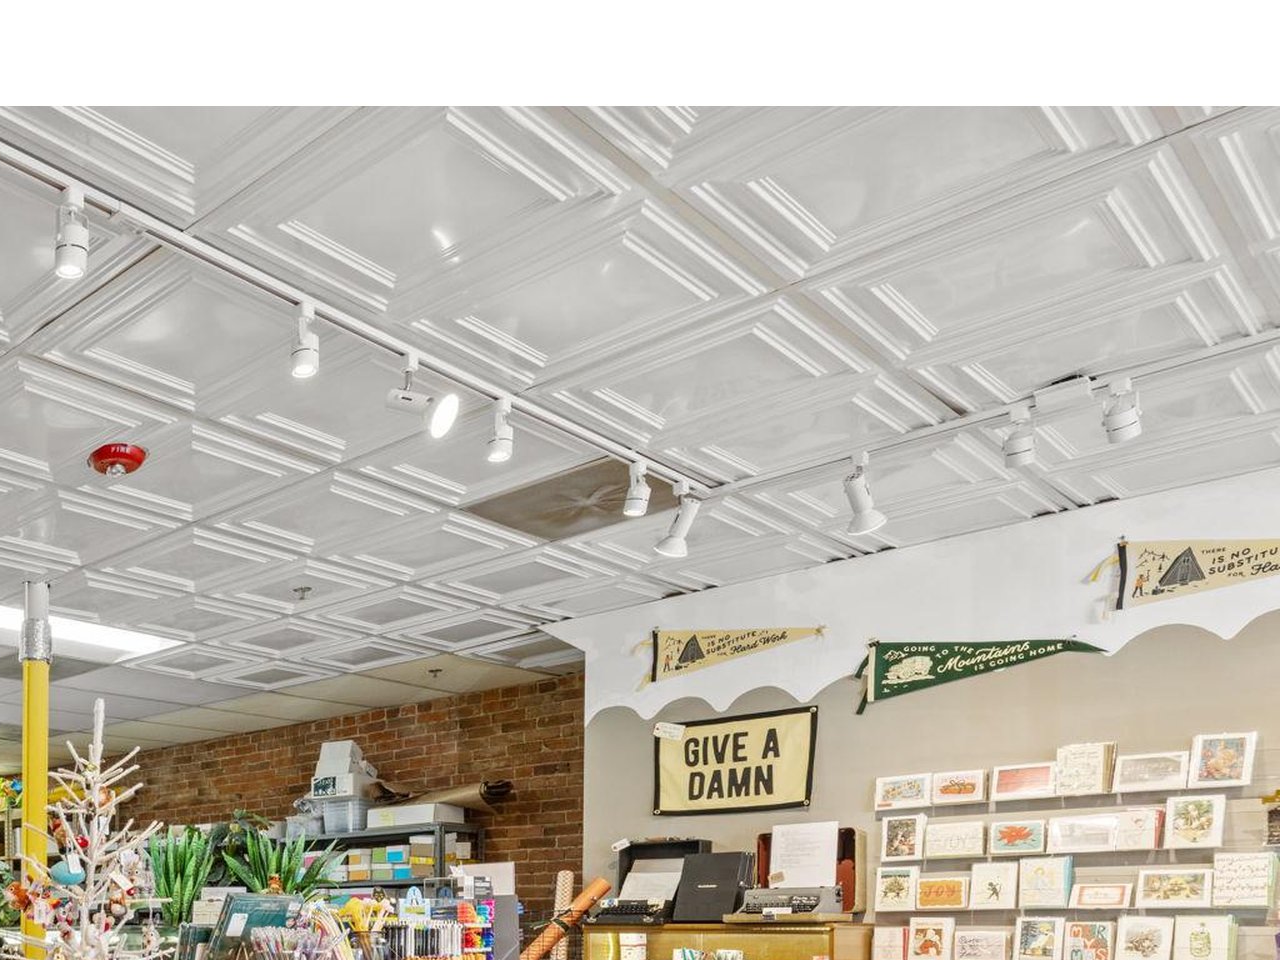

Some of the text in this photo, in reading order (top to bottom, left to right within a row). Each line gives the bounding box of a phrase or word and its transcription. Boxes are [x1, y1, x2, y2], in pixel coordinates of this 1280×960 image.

[1212, 547, 1251, 564] IS NO
[705, 630, 757, 655] SUBSTITUTE
[718, 634, 731, 643] NO
[730, 640, 759, 655] Hard
[759, 630, 788, 646] Work
[935, 649, 949, 659] TO
[954, 645, 975, 655] THE
[937, 641, 1031, 674] Mountains
[974, 643, 1064, 671] IS GOING HOME
[684, 731, 749, 768] GIVE
[761, 728, 780, 760] A
[688, 764, 774, 801] DAMN
